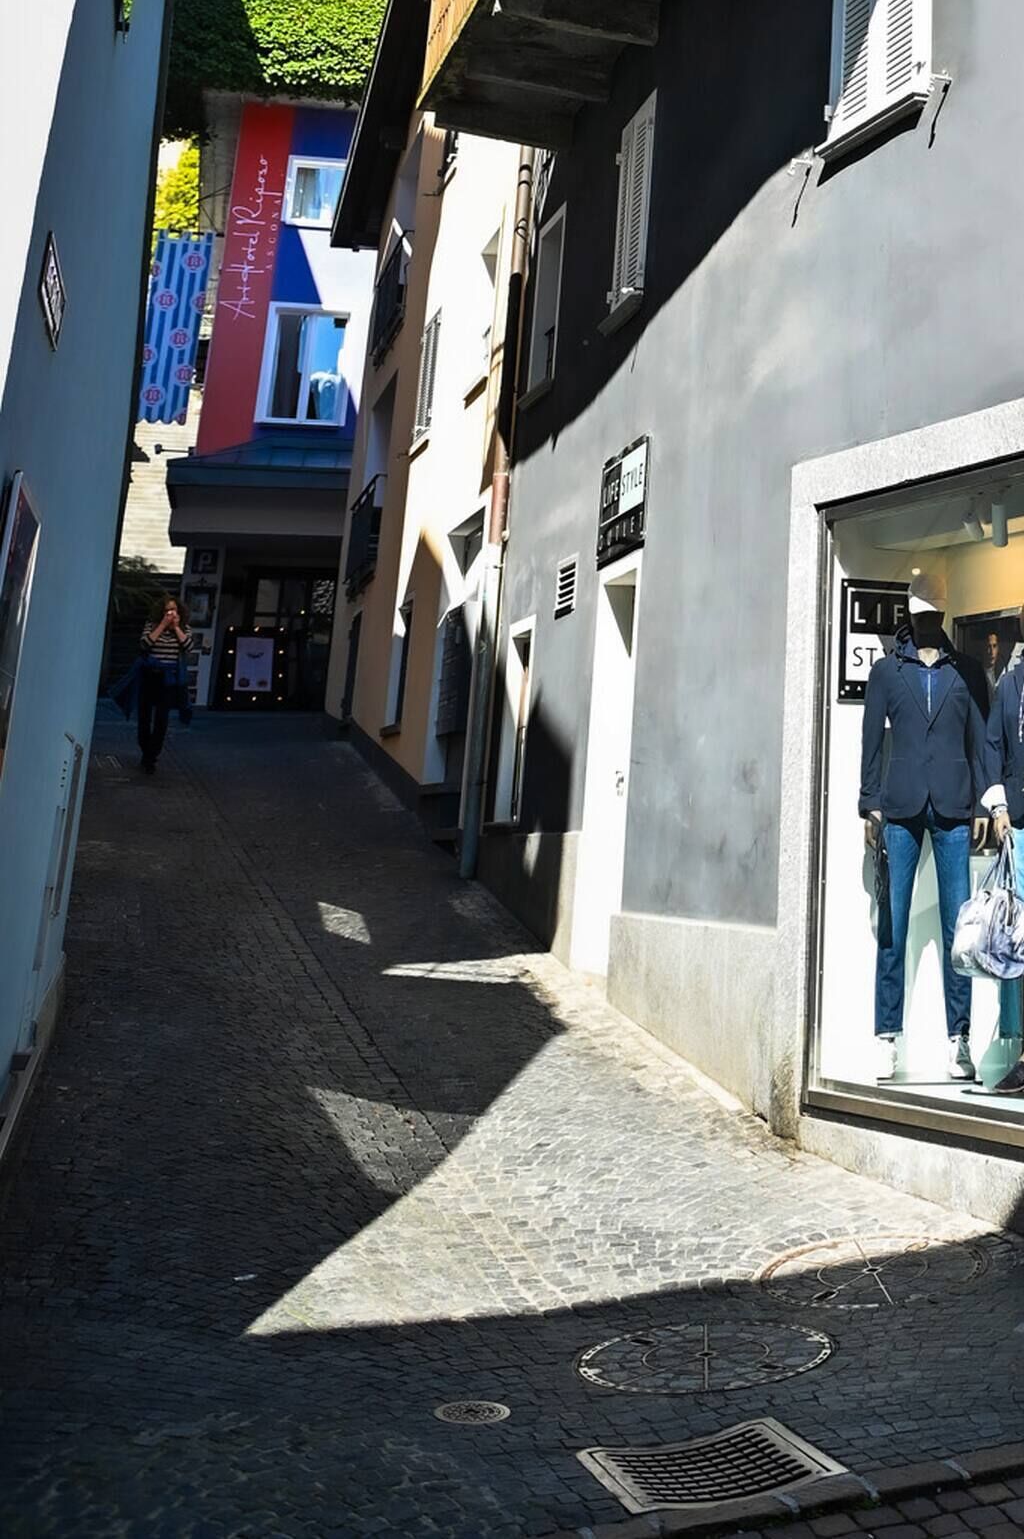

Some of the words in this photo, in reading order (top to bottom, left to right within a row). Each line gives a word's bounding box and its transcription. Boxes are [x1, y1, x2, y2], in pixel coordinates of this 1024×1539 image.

[232, 155, 282, 225] Riposo
[266, 200, 281, 270] ASCONA
[603, 479, 619, 507] LIFE
[621, 463, 643, 496] STYLE
[599, 511, 643, 550] OUTLET
[854, 601, 904, 624] LIF
